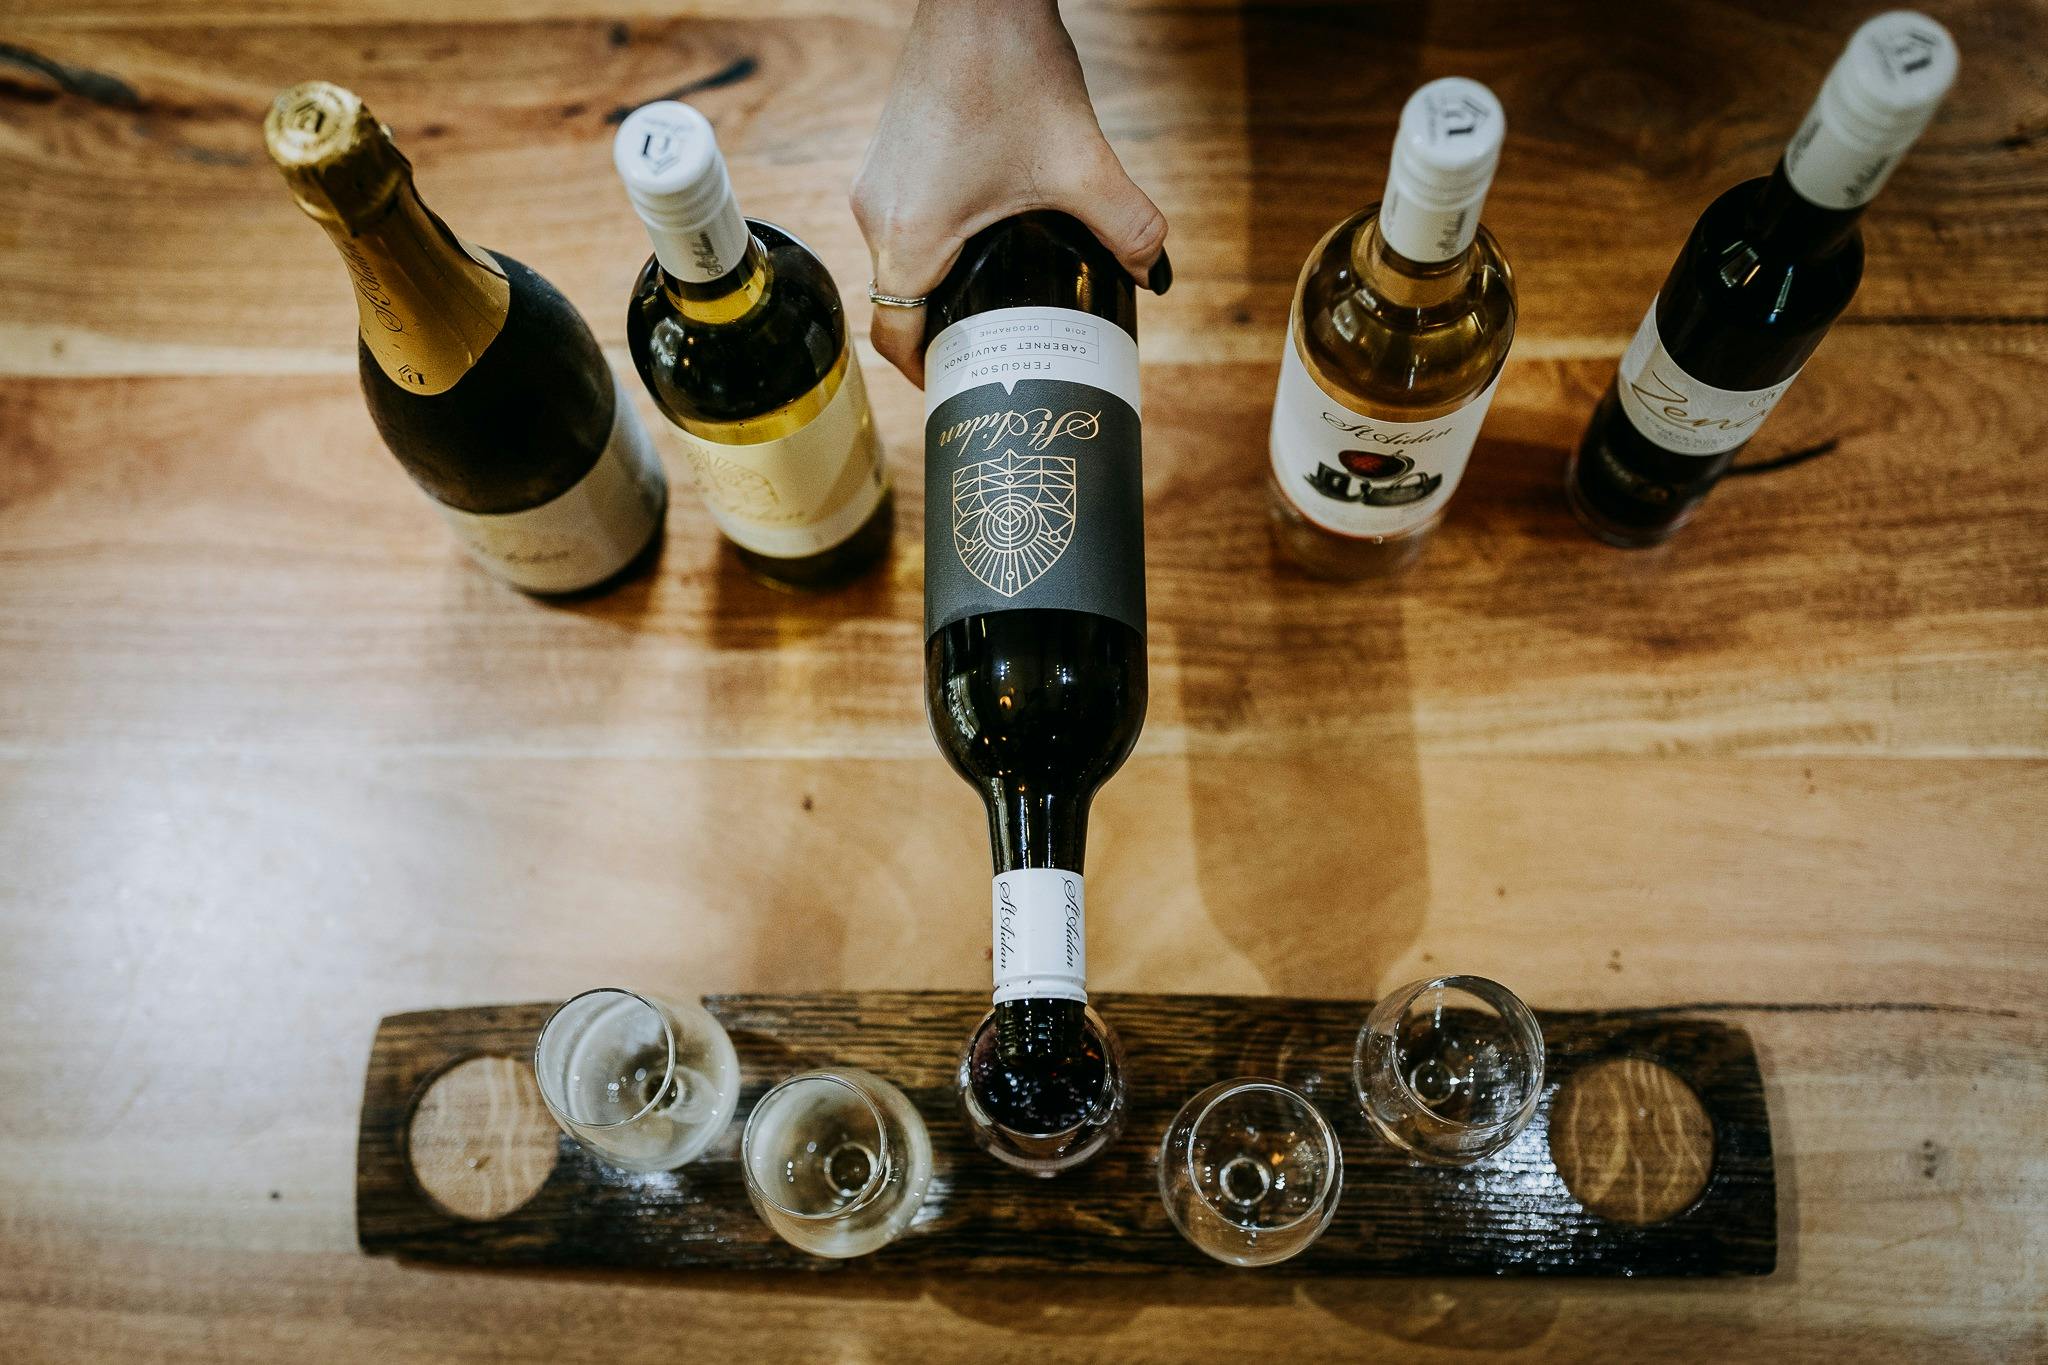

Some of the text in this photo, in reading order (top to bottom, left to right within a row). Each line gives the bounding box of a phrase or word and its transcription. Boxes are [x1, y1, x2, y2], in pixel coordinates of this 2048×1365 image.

[979, 324, 1040, 337] GEOGRAPHE
[944, 342, 1087, 371] CABERNET SAUVIGNON
[970, 361, 1052, 379] FERGUSON
[939, 408, 1102, 458] St Aidan
[1320, 411, 1453, 445] St Aidan
[998, 881, 1018, 970] St Aidan
[1061, 876, 1081, 970] St Aidan
